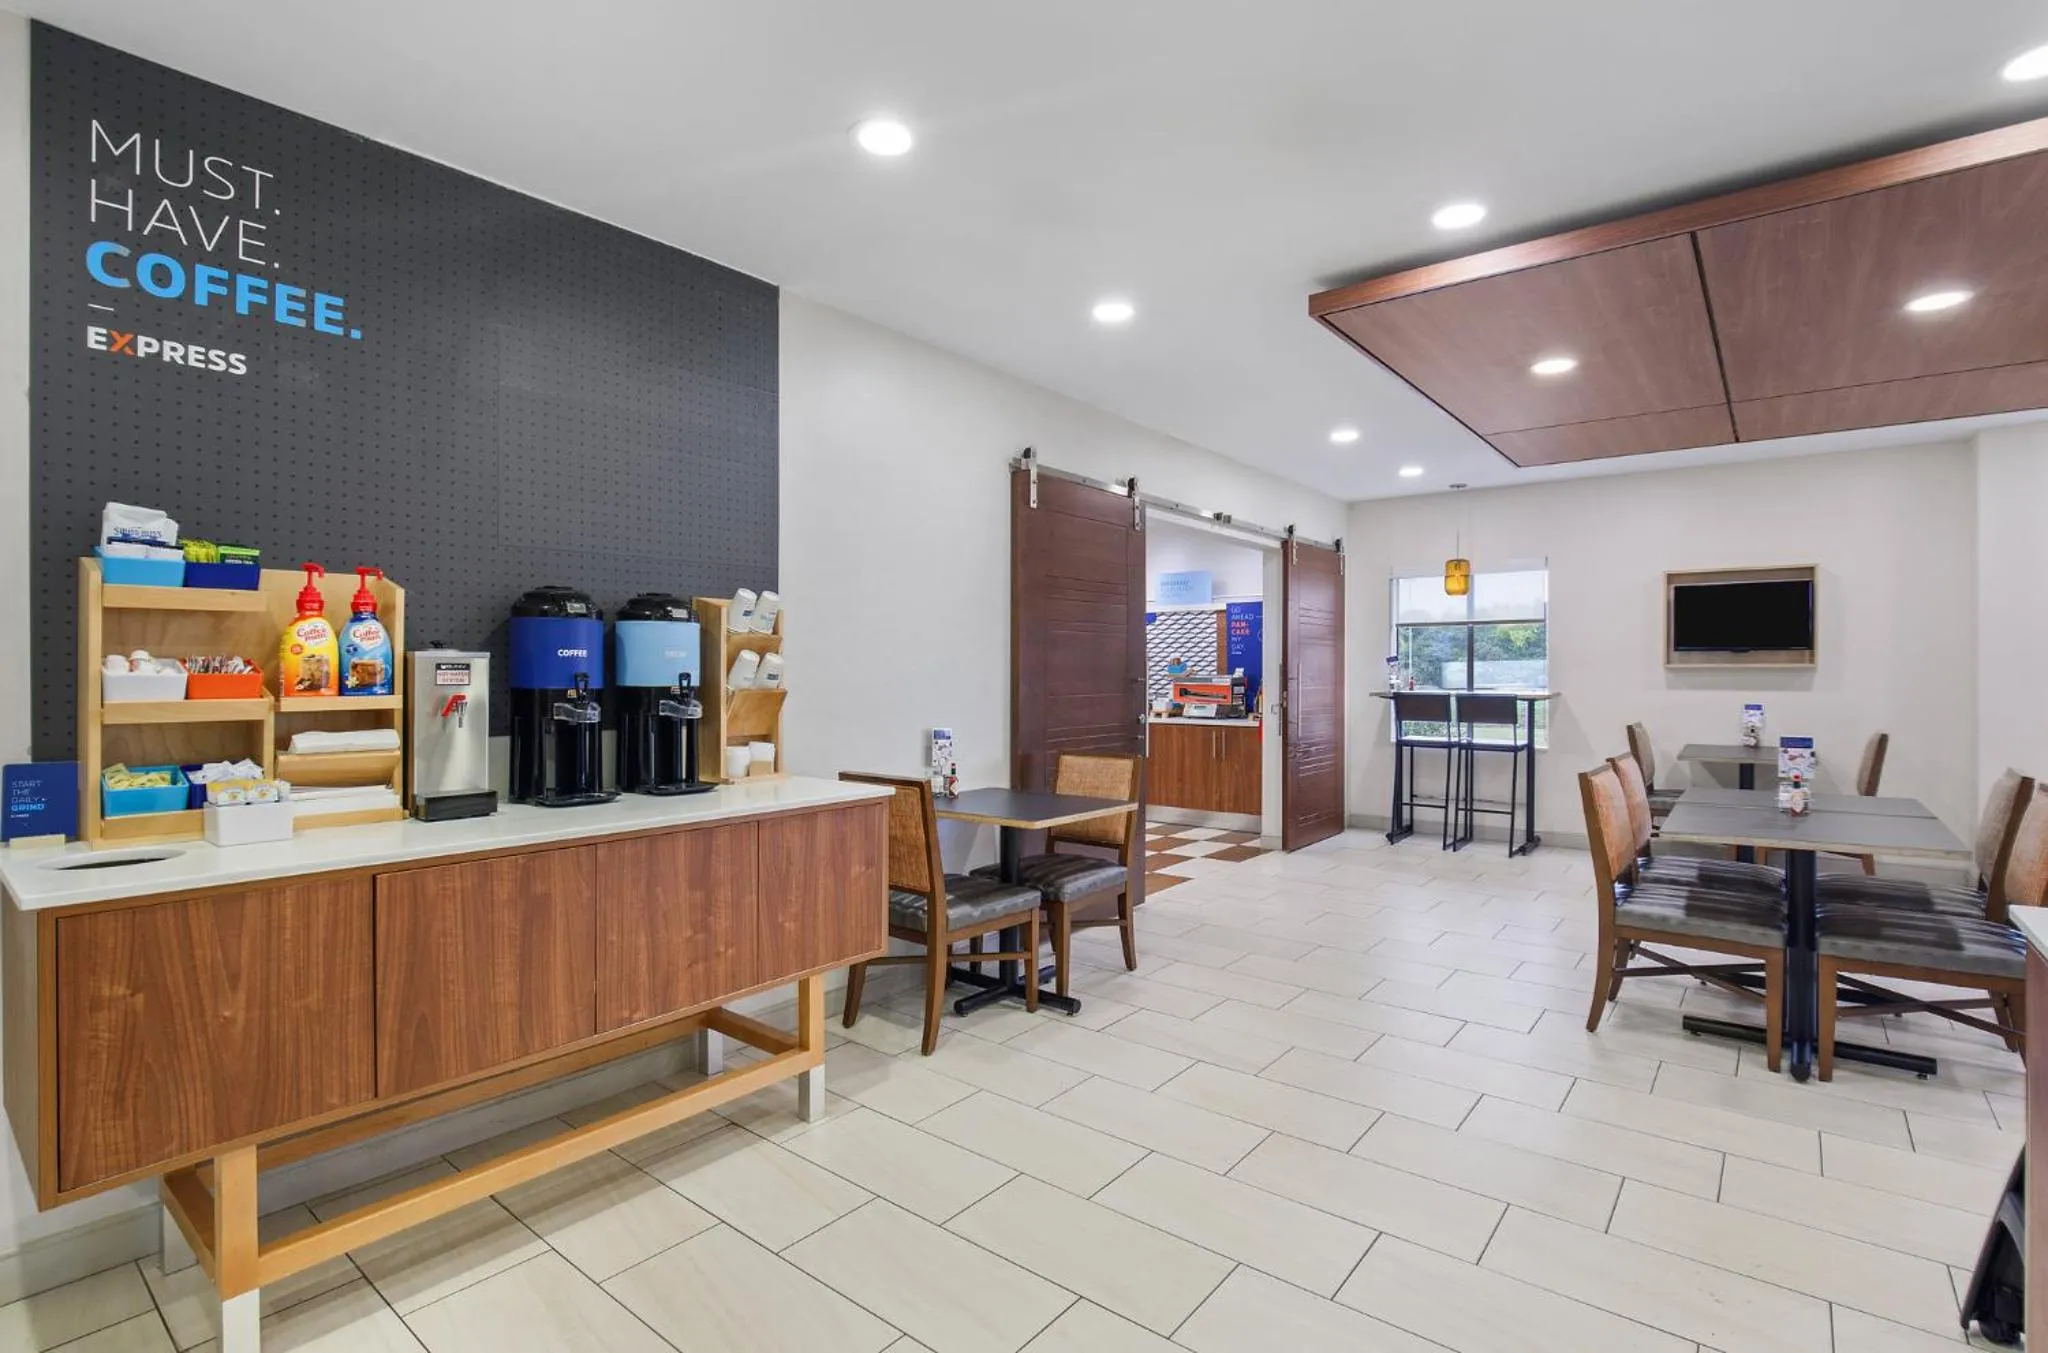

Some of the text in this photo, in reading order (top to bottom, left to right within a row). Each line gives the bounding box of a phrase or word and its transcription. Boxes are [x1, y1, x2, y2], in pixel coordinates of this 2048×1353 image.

[91, 119, 281, 215] MUST.
[90, 178, 280, 269] HAVE.
[85, 240, 364, 340] COFFEE.
[86, 325, 248, 376] EXPRESS
[557, 649, 588, 657] COFFEE
[11, 780, 42, 788] START
[11, 803, 45, 812] GRIND
